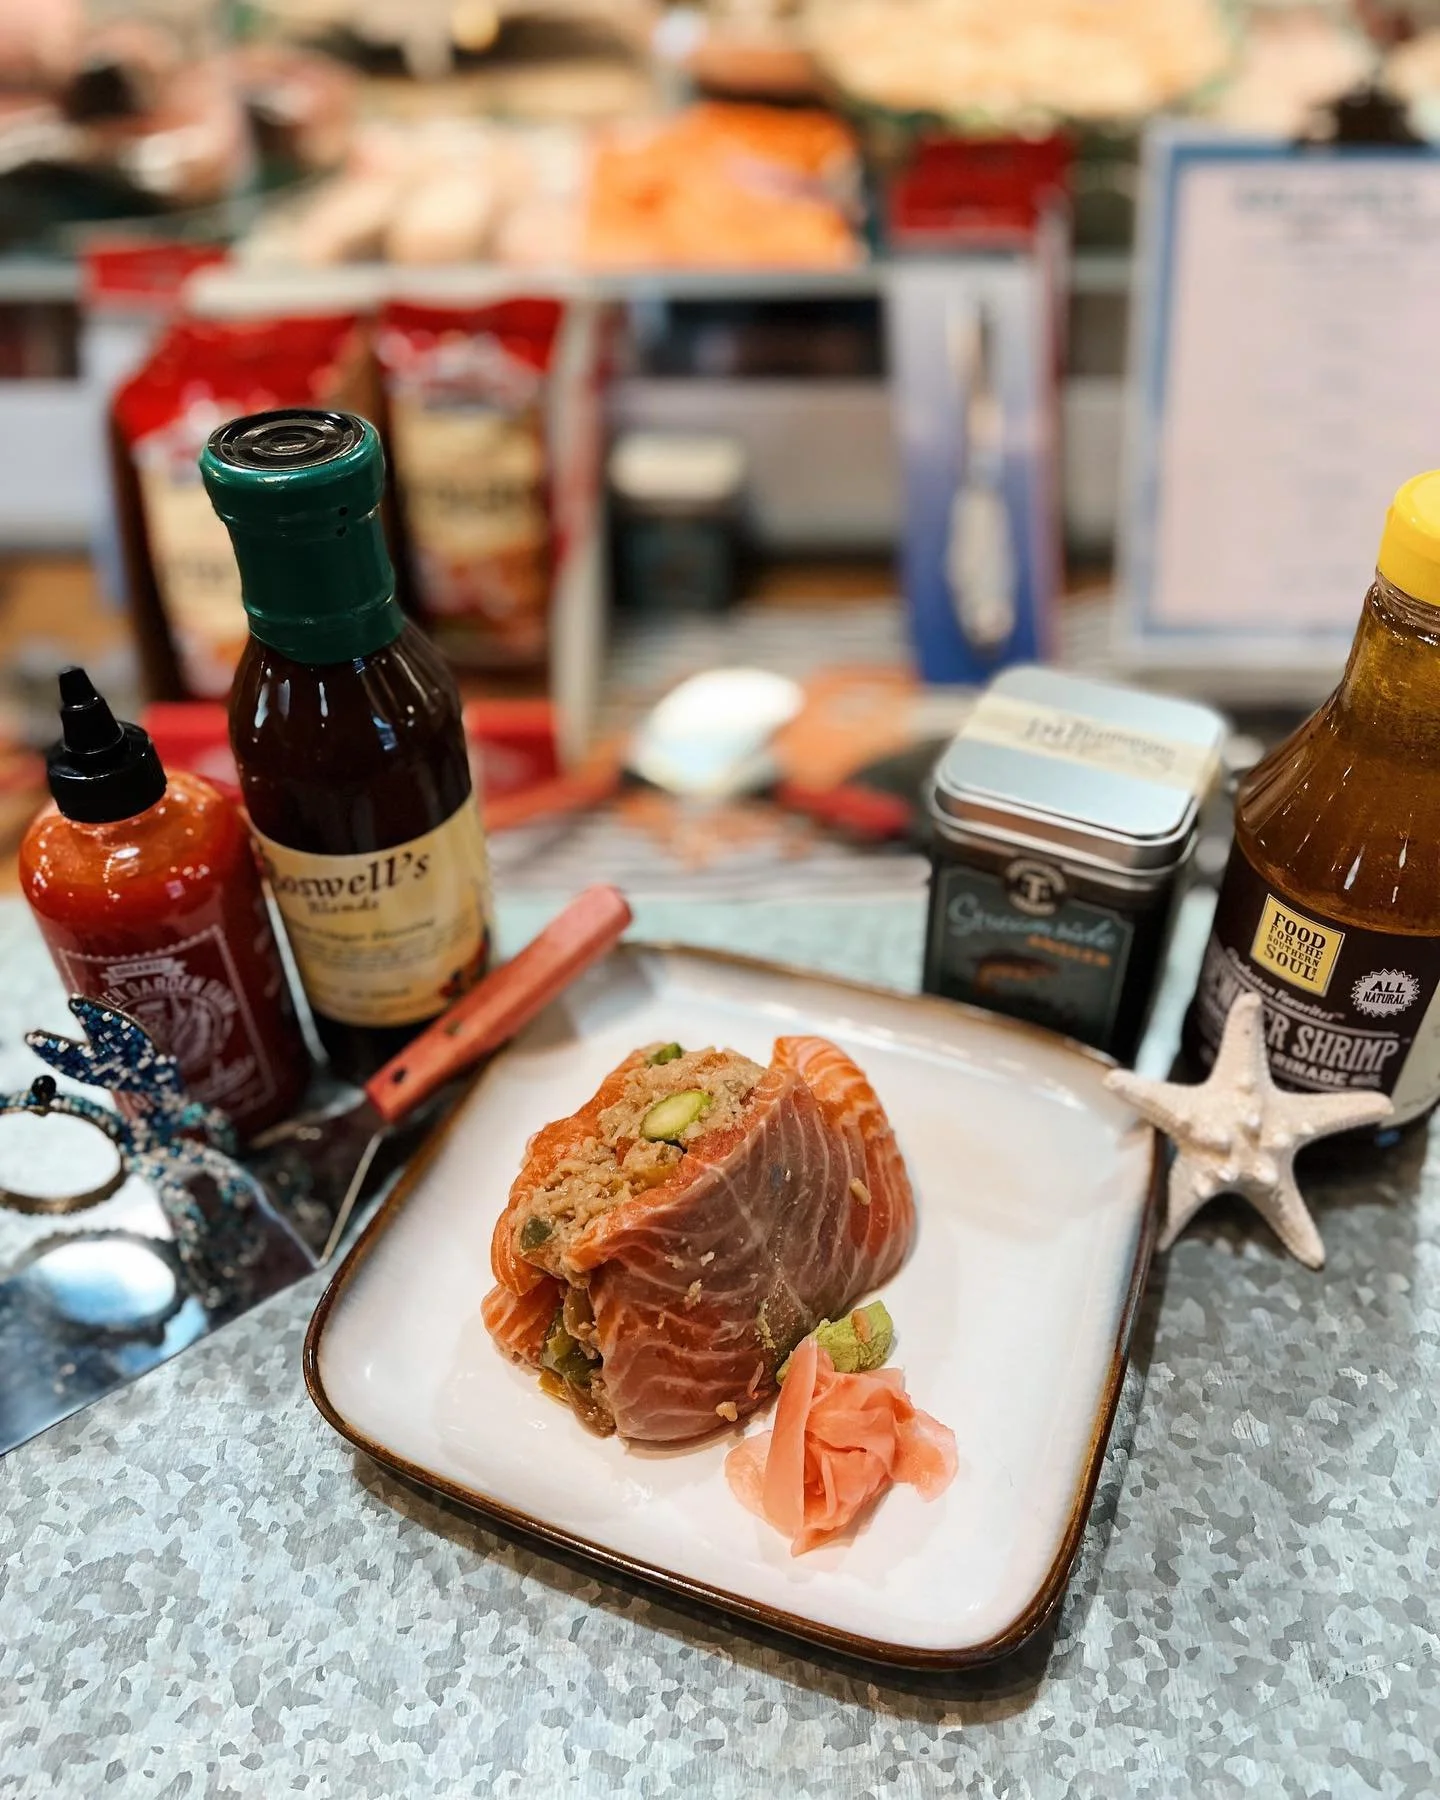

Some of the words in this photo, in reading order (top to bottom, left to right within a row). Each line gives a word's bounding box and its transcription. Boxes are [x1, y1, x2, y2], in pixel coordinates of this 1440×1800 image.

[275, 851, 430, 897] oswell's
[1270, 925, 1293, 946] FOR
[1297, 941, 1323, 960] THE
[1272, 911, 1326, 949] FOOD
[1264, 943, 1315, 982] SOUL
[1267, 934, 1320, 967] SOUTHERN
[1362, 991, 1405, 1005] NATURAL
[1370, 980, 1406, 993] ALL
[1291, 1024, 1399, 1072] SHRIMP
